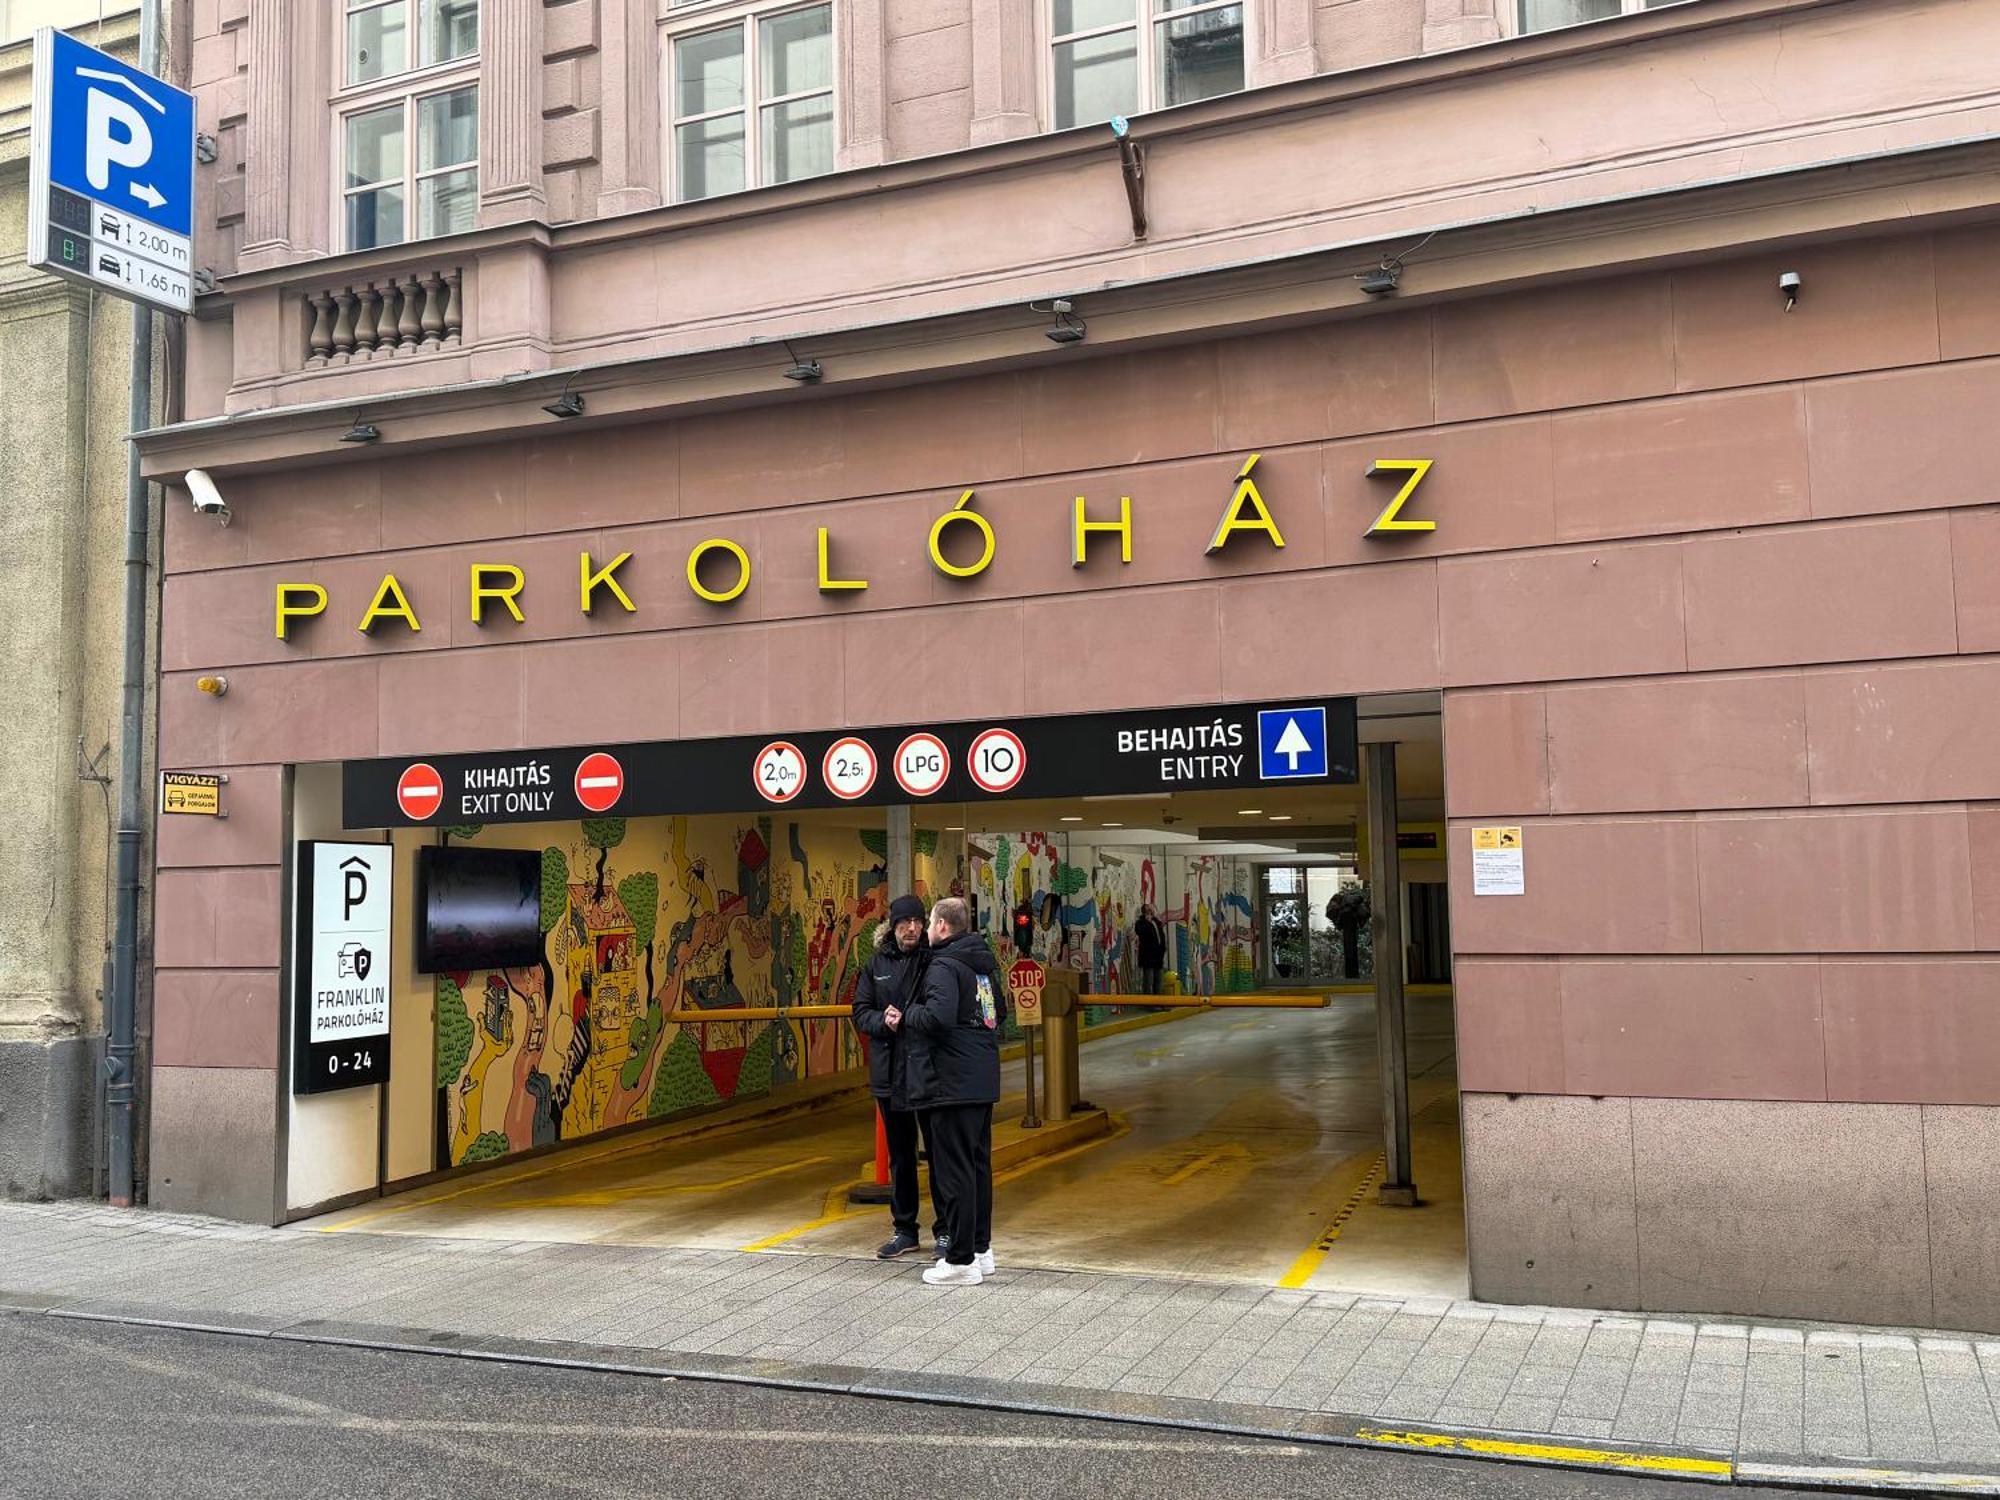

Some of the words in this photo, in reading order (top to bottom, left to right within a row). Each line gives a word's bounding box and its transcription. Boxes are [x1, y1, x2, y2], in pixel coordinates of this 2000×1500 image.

[86, 87, 153, 190] P
[173, 246, 187, 260] m
[172, 283, 186, 298] m
[275, 453, 1438, 640] PARKOLÓHÁZ
[1118, 718, 1243, 752] BEHAJTÁS
[905, 755, 940, 773] LPG
[983, 747, 1014, 773] 10
[1161, 754, 1243, 780] ENTRY
[165, 774, 218, 785] VIGYÁZZ!
[464, 760, 551, 789] KIHAJTÁS
[462, 794, 500, 815] EXIT
[505, 791, 554, 813] ONLY
[344, 871, 368, 921] P
[359, 955, 368, 973] P
[1010, 970, 1042, 988] STOP
[317, 987, 385, 1009] FRANKLIN
[317, 1008, 384, 1030] PARKOLÓHÁZ
[353, 1051, 372, 1070] 24
